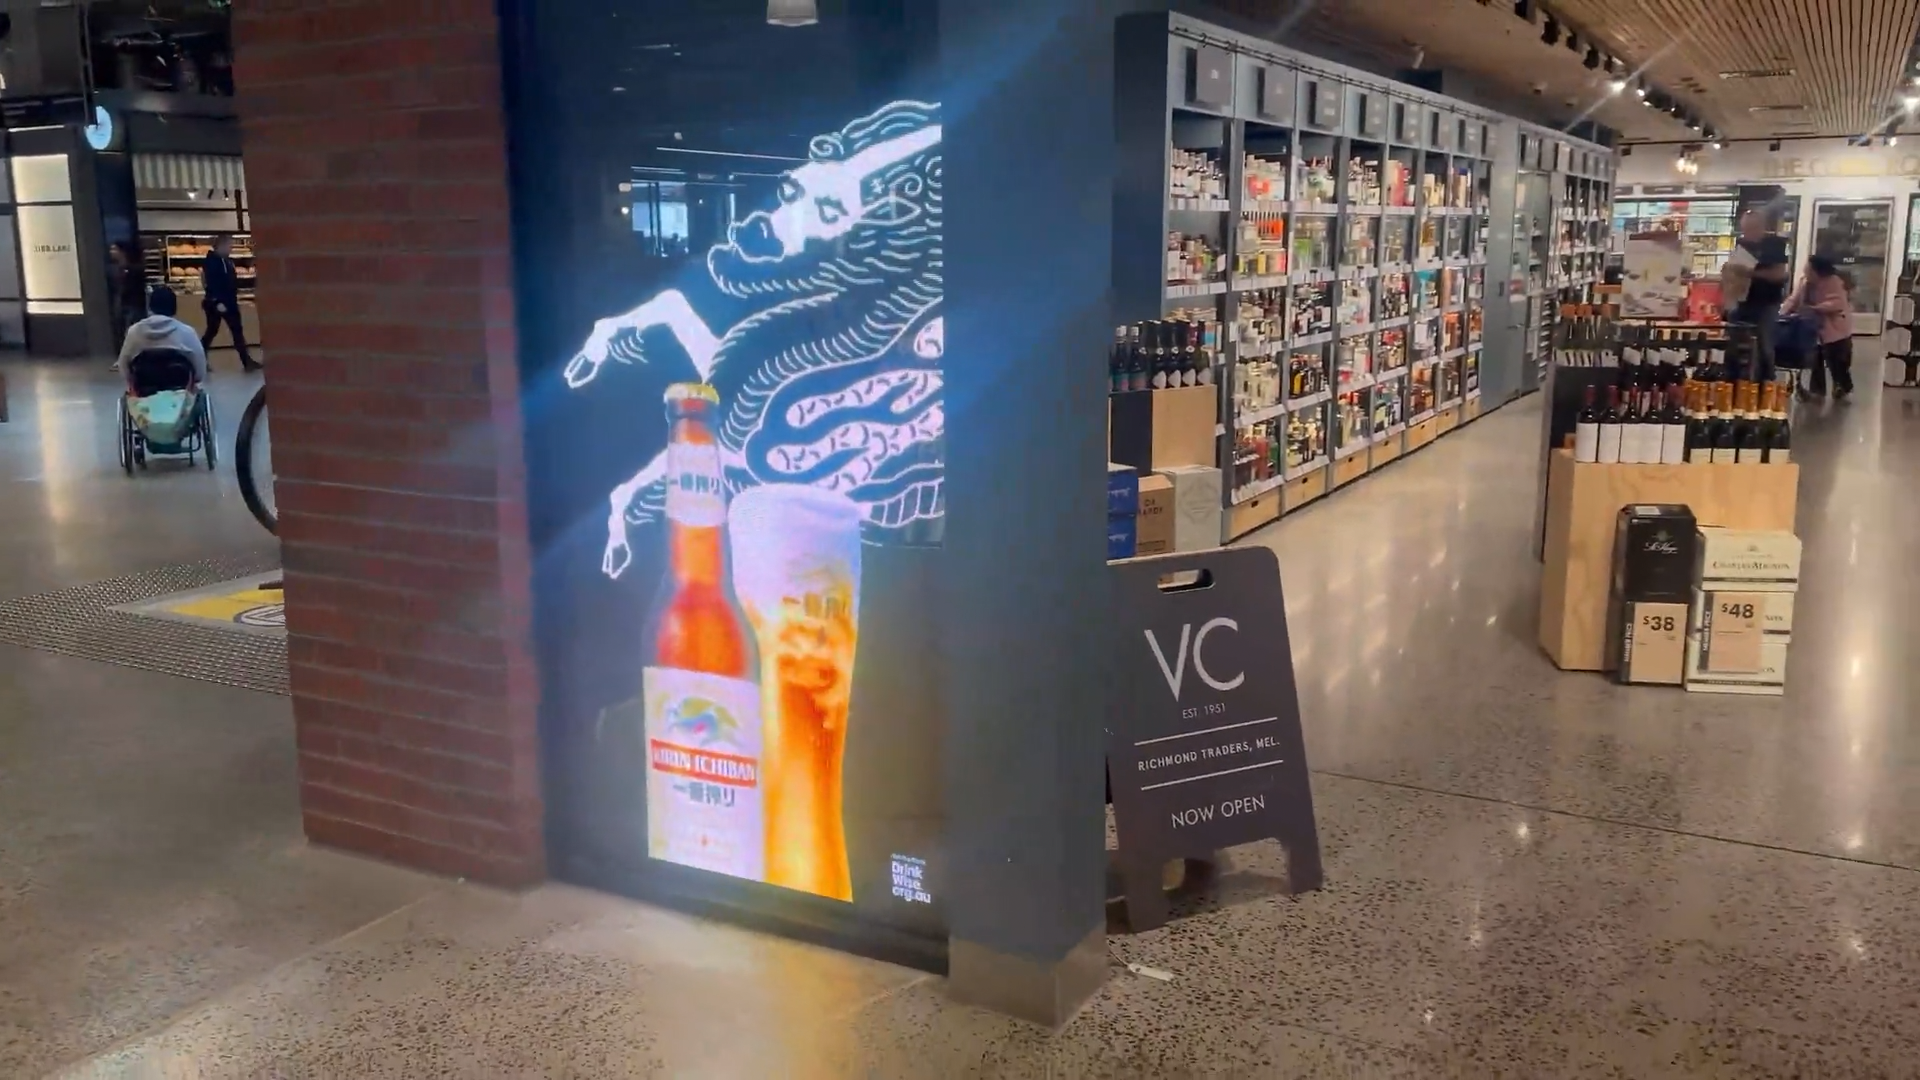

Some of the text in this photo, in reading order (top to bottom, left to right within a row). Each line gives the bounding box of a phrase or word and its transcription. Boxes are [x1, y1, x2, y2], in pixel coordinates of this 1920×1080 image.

[1721, 602, 1755, 619] $48
[1642, 615, 1675, 632] $38
[1143, 616, 1246, 703] VC
[1204, 702, 1226, 715] 1951
[1138, 736, 1280, 771] RICHMOND TRADERS, MEL.
[1171, 794, 1265, 829] NOW OPEN
[892, 860, 923, 879] Drink
